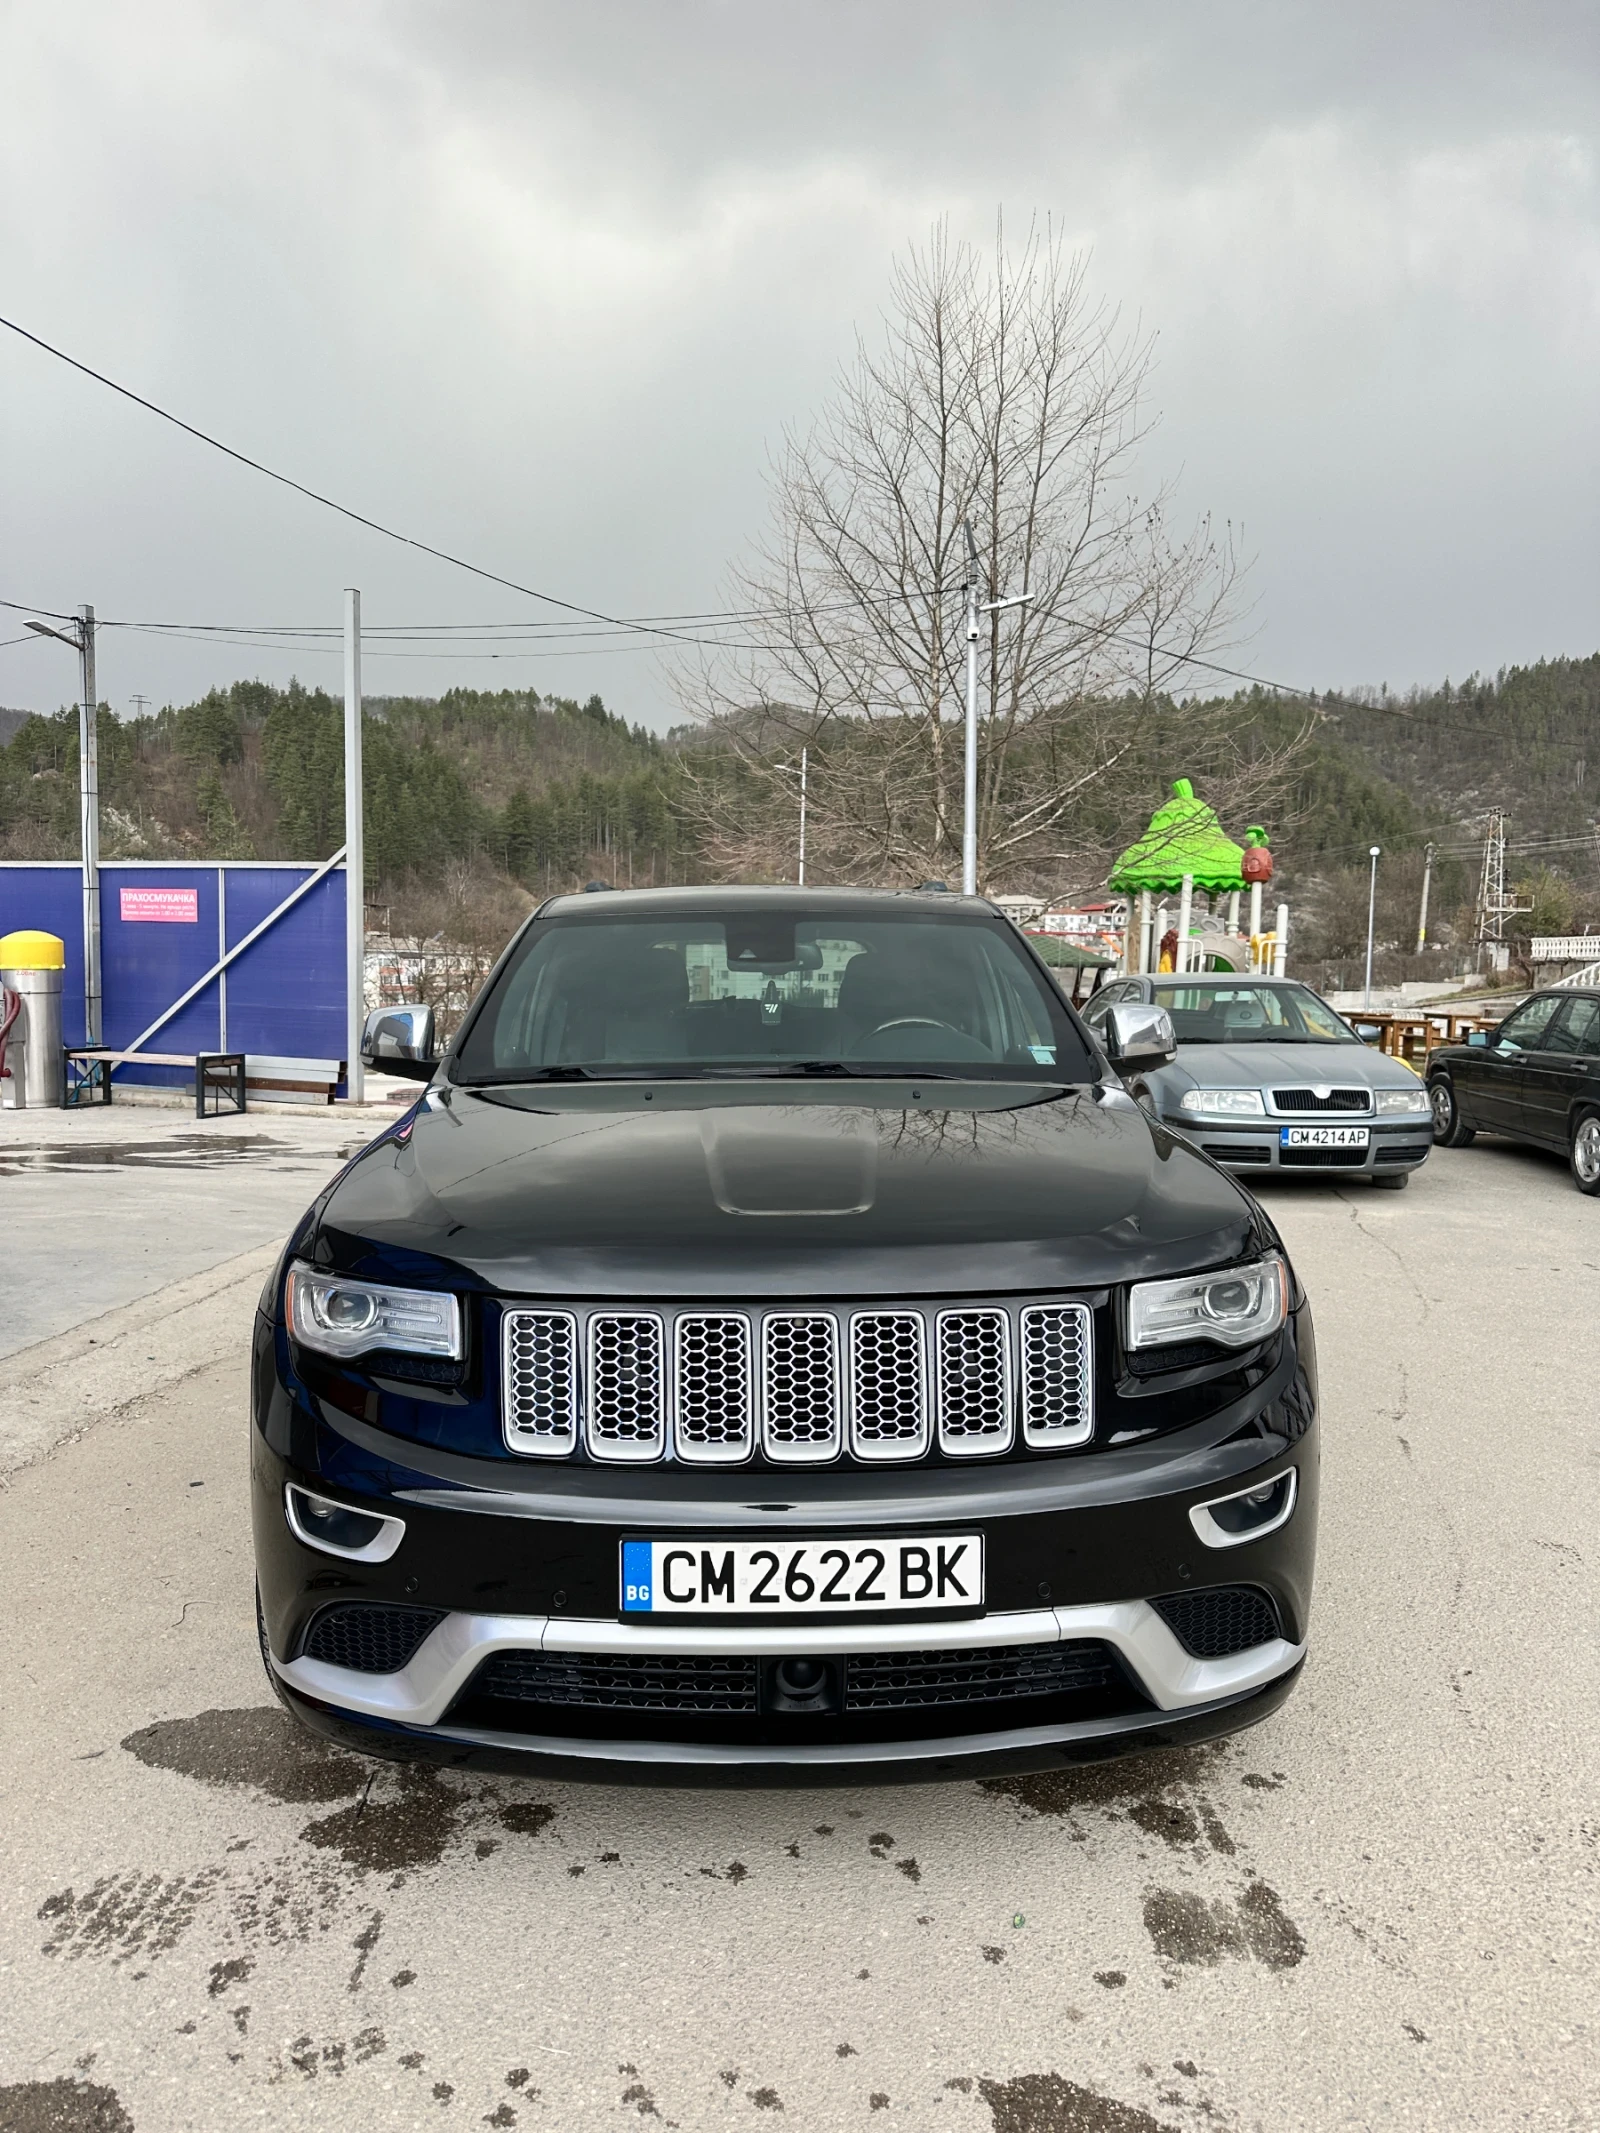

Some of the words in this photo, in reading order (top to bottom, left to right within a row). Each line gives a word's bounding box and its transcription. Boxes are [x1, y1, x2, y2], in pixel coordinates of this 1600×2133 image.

[122, 893, 195, 903] ПРАХОСМУКАЧКА
[1291, 1130, 1309, 1144] CM
[1312, 1130, 1345, 1144] 4214
[1348, 1130, 1366, 1144] AP
[663, 1550, 735, 1603] CM
[749, 1548, 886, 1603] 2622
[900, 1544, 970, 1600] BK
[626, 1585, 650, 1601] BG
